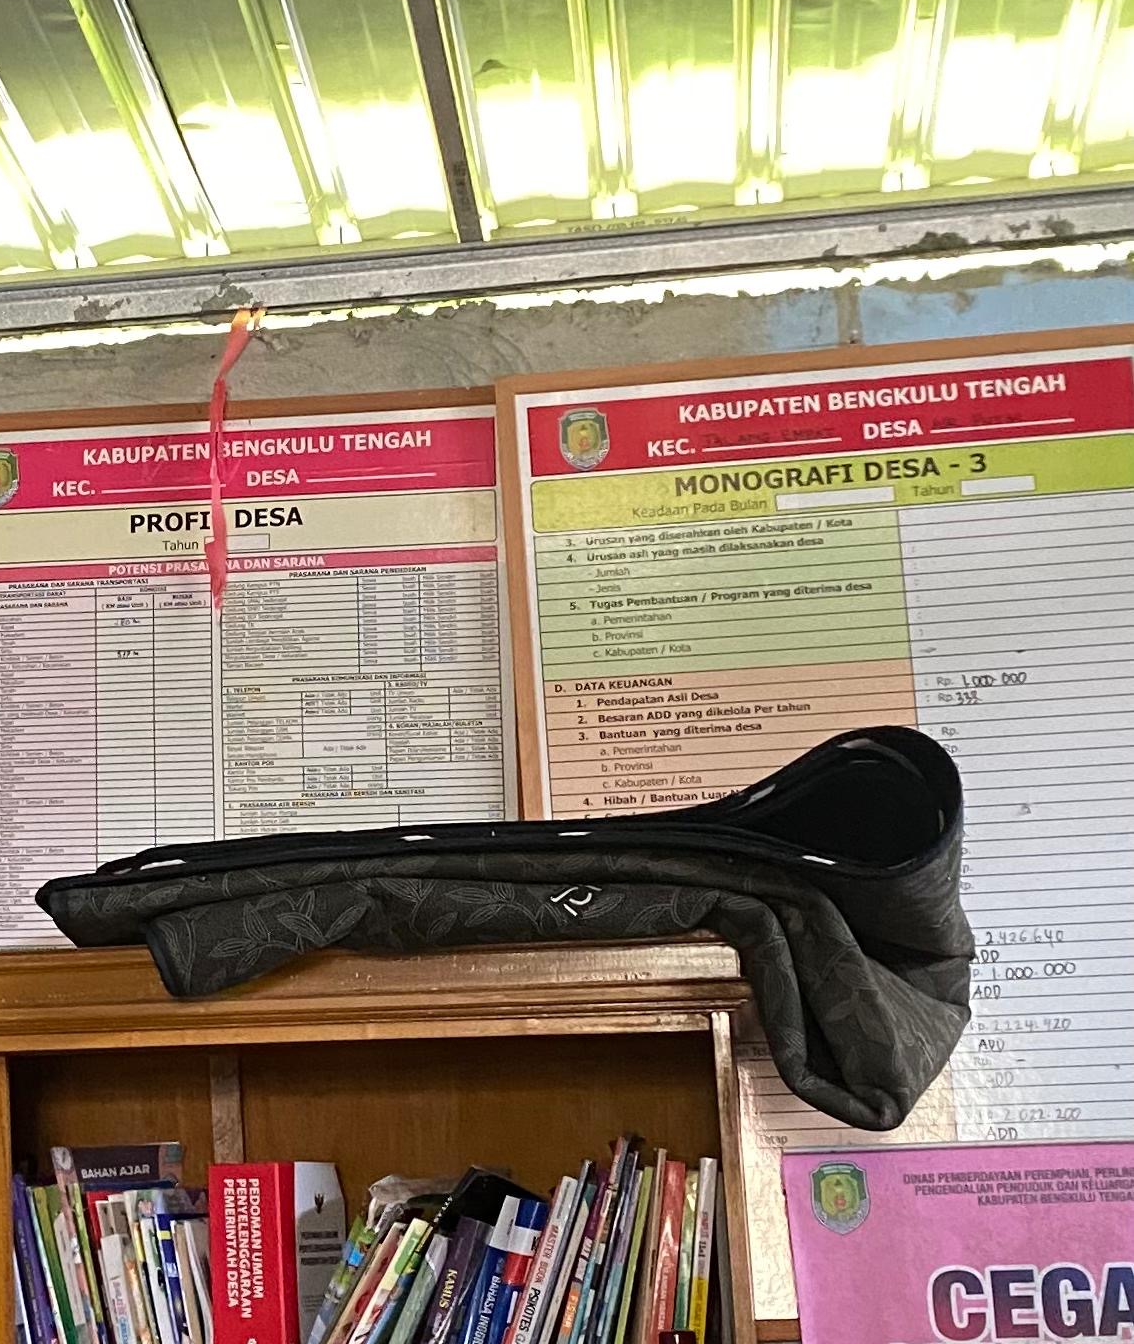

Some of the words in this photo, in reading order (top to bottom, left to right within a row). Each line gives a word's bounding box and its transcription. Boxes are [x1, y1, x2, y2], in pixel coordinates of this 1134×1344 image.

[679, 394, 820, 424] KABUPATEN
[827, 383, 959, 411] BENGKULU
[964, 373, 1066, 399] TENGAH
[83, 443, 210, 466] KABUPATEN
[340, 429, 431, 451] TENGAH
[647, 439, 695, 457] KEC.
[863, 419, 923, 440] DESA
[53, 480, 96, 497] KEC.
[246, 468, 300, 487] DESA
[675, 464, 854, 496] MONOGRAFI
[865, 457, 941, 482] DESA
[970, 453, 987, 473] 3
[632, 506, 690, 520] Keadaan
[693, 502, 725, 515] Pada
[730, 499, 767, 512] Bulan
[913, 485, 955, 497] Tahun
[130, 511, 212, 534] PROFI
[234, 507, 303, 528] DESA
[566, 538, 575, 547] 3.
[586, 537, 625, 546] Urusan
[629, 534, 655, 545] yang
[659, 528, 721, 542] diserahkan
[751, 520, 813, 535] Kabupaten
[826, 518, 853, 528] Kota
[162, 540, 199, 552] Tahun
[566, 554, 577, 563] 4.
[586, 551, 626, 562] Urusan
[652, 547, 679, 561] yang
[682, 544, 716, 555] masih
[719, 538, 794, 553] dilaksanakan
[797, 536, 824, 547] desa
[109, 562, 162, 576] POTENSI
[244, 557, 264, 570] DAN
[267, 555, 325, 569] SARANA
[569, 601, 581, 610] 5.
[589, 599, 623, 610] Tugas
[626, 593, 698, 607] Pembantuan
[711, 589, 760, 604] Program
[762, 587, 791, 599] yang
[793, 583, 842, 595] diterima
[845, 581, 872, 591] desa
[603, 612, 672, 625] Pemerintahan
[605, 630, 643, 641] Provinsi
[605, 645, 658, 659] Kabupaten
[669, 643, 692, 653] Kota
[575, 682, 606, 691] DATA
[609, 677, 673, 689] KEUANGAN
[576, 700, 586, 708] 1.
[597, 695, 664, 707] Pendapatan
[691, 691, 719, 700] Desa
[578, 716, 588, 724] 2.
[598, 713, 644, 723] Besaran
[646, 711, 672, 720] ADD
[674, 709, 702, 720] yang
[706, 706, 751, 716] dikelola
[754, 705, 774, 714] Per
[777, 702, 811, 711] tahun
[578, 732, 589, 741] 3.
[599, 730, 646, 740] Bantuan
[653, 728, 680, 738] yang
[684, 724, 732, 735] diterima
[735, 723, 762, 731] desa
[613, 743, 682, 755] Pemerintahan
[614, 761, 653, 771] Provinsi
[615, 777, 667, 789] Kabupaten
[679, 775, 702, 784] Kota
[583, 797, 593, 806] 4.
[604, 795, 636, 805] Hibah
[650, 792, 698, 803] Bantuan
[81, 1167, 117, 1179] BAHAN
[120, 1165, 150, 1176] AJAR
[224, 1178, 238, 1268] PEMERINTAH
[249, 1178, 262, 1251] PEDOMAN
[236, 1178, 252, 1319] PENYELENGGARAAN
[226, 1270, 239, 1307] DESA
[252, 1253, 264, 1299] UMUM
[439, 1268, 458, 1309] KAMUS
[484, 1275, 501, 1315] BAHASA
